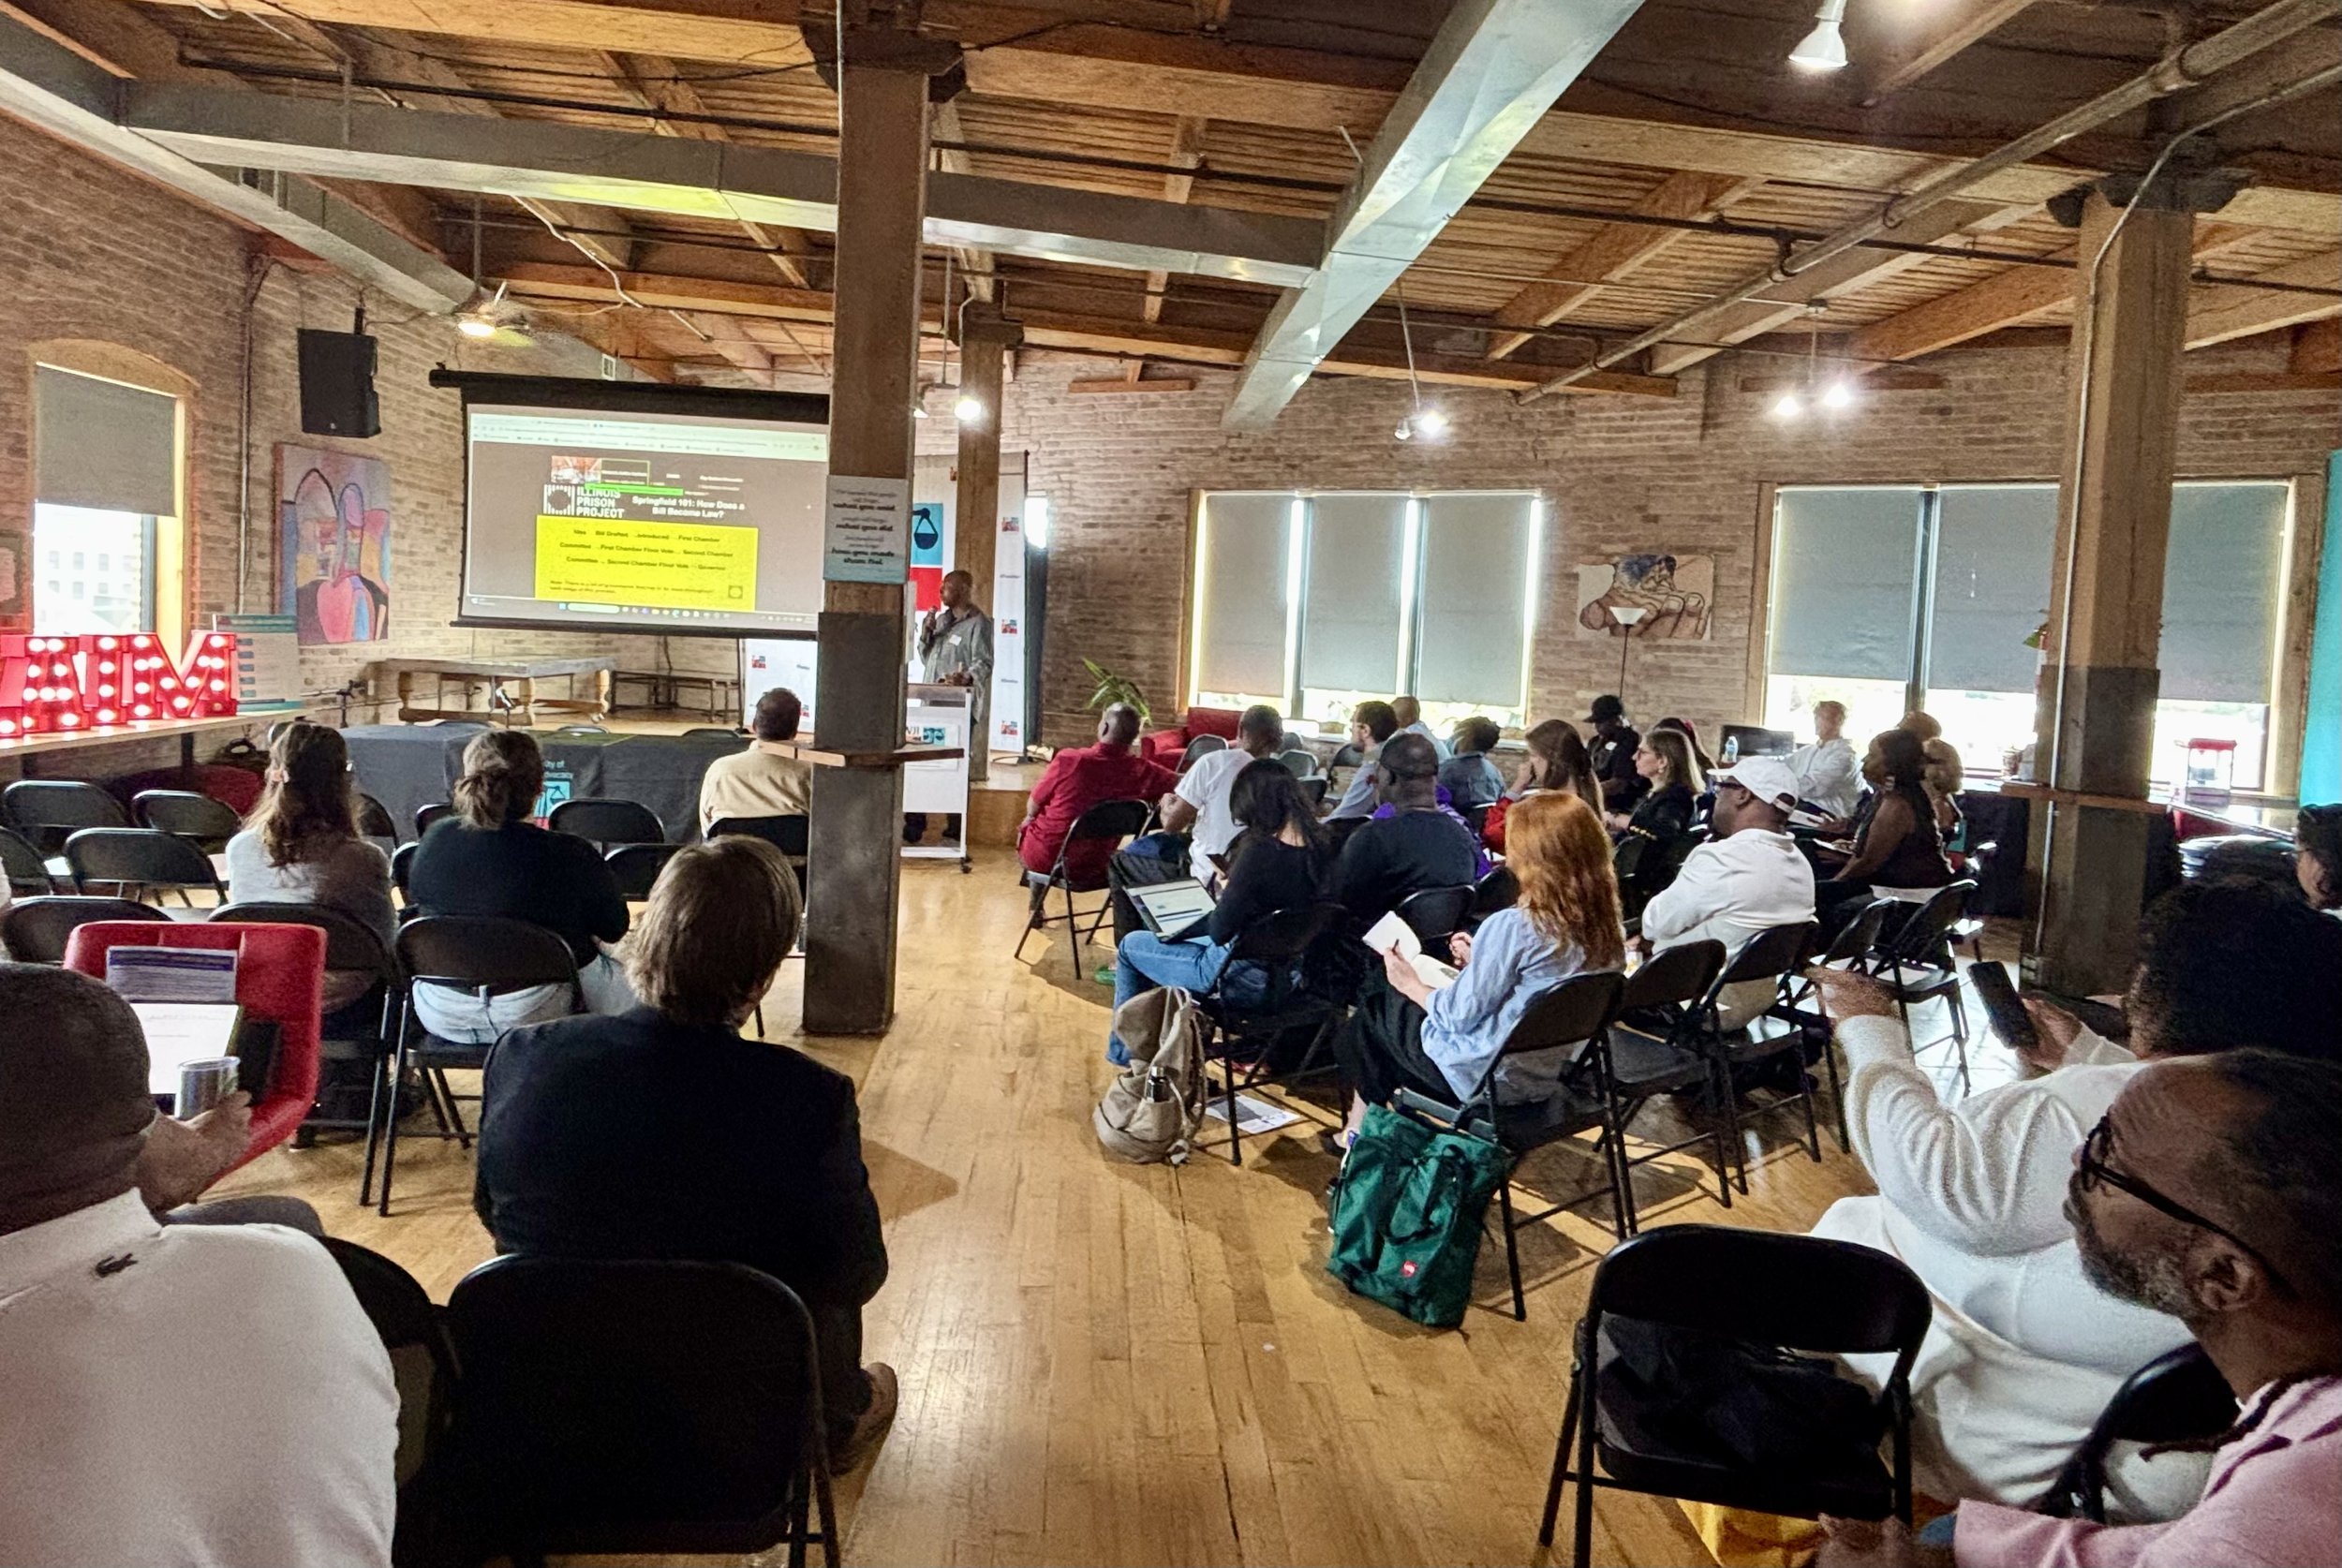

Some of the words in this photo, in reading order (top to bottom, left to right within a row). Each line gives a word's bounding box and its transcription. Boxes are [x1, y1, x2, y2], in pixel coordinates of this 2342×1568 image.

[576, 485, 621, 499] ILLINOIS
[576, 496, 615, 508] PRISON
[696, 499, 716, 509] How
[576, 507, 625, 519] PROJECT
[702, 510, 725, 519] Law?
[0, 634, 237, 738] AIM
